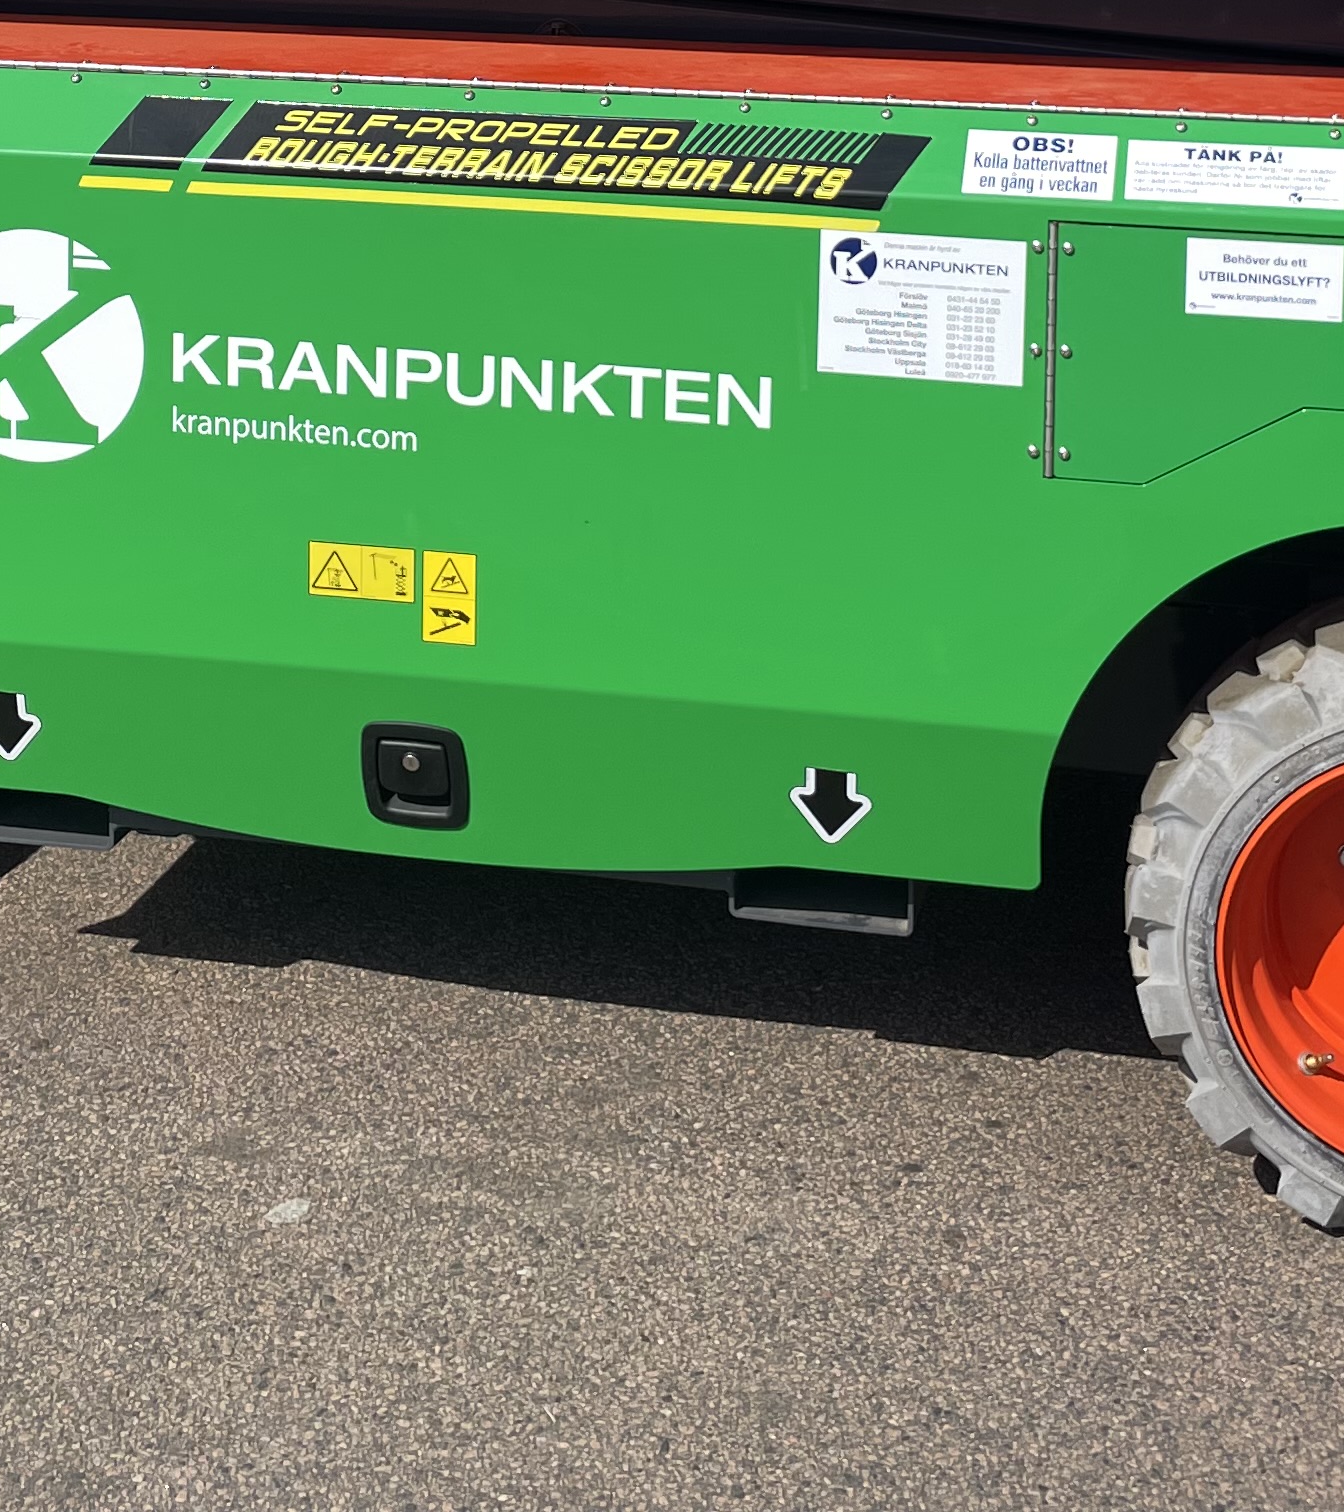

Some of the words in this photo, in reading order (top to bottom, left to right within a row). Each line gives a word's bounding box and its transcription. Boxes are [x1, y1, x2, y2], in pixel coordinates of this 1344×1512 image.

[274, 108, 681, 153] SELF-PROPELLED
[1012, 136, 1074, 154] OBS!
[1184, 144, 1242, 163] TÄNK
[1249, 146, 1284, 164] PÅ!
[244, 137, 555, 184] ROUGH-TERRAIN
[553, 155, 729, 192] SCISSOR
[740, 164, 854, 201] LIFTS
[973, 152, 1008, 170] Kolla
[978, 175, 996, 189] en
[1000, 172, 1035, 194] gång
[1048, 176, 1098, 194] veckan
[882, 257, 1008, 277] KRANPUNKTEN
[1222, 253, 1270, 266] Behöver
[1273, 256, 1287, 267] du
[1289, 257, 1308, 268] ett
[1198, 271, 1331, 288] UTBILDNINGSLYFT?
[171, 332, 772, 430] KRANPUNKTEN
[170, 406, 418, 453] kranpunkten.com
